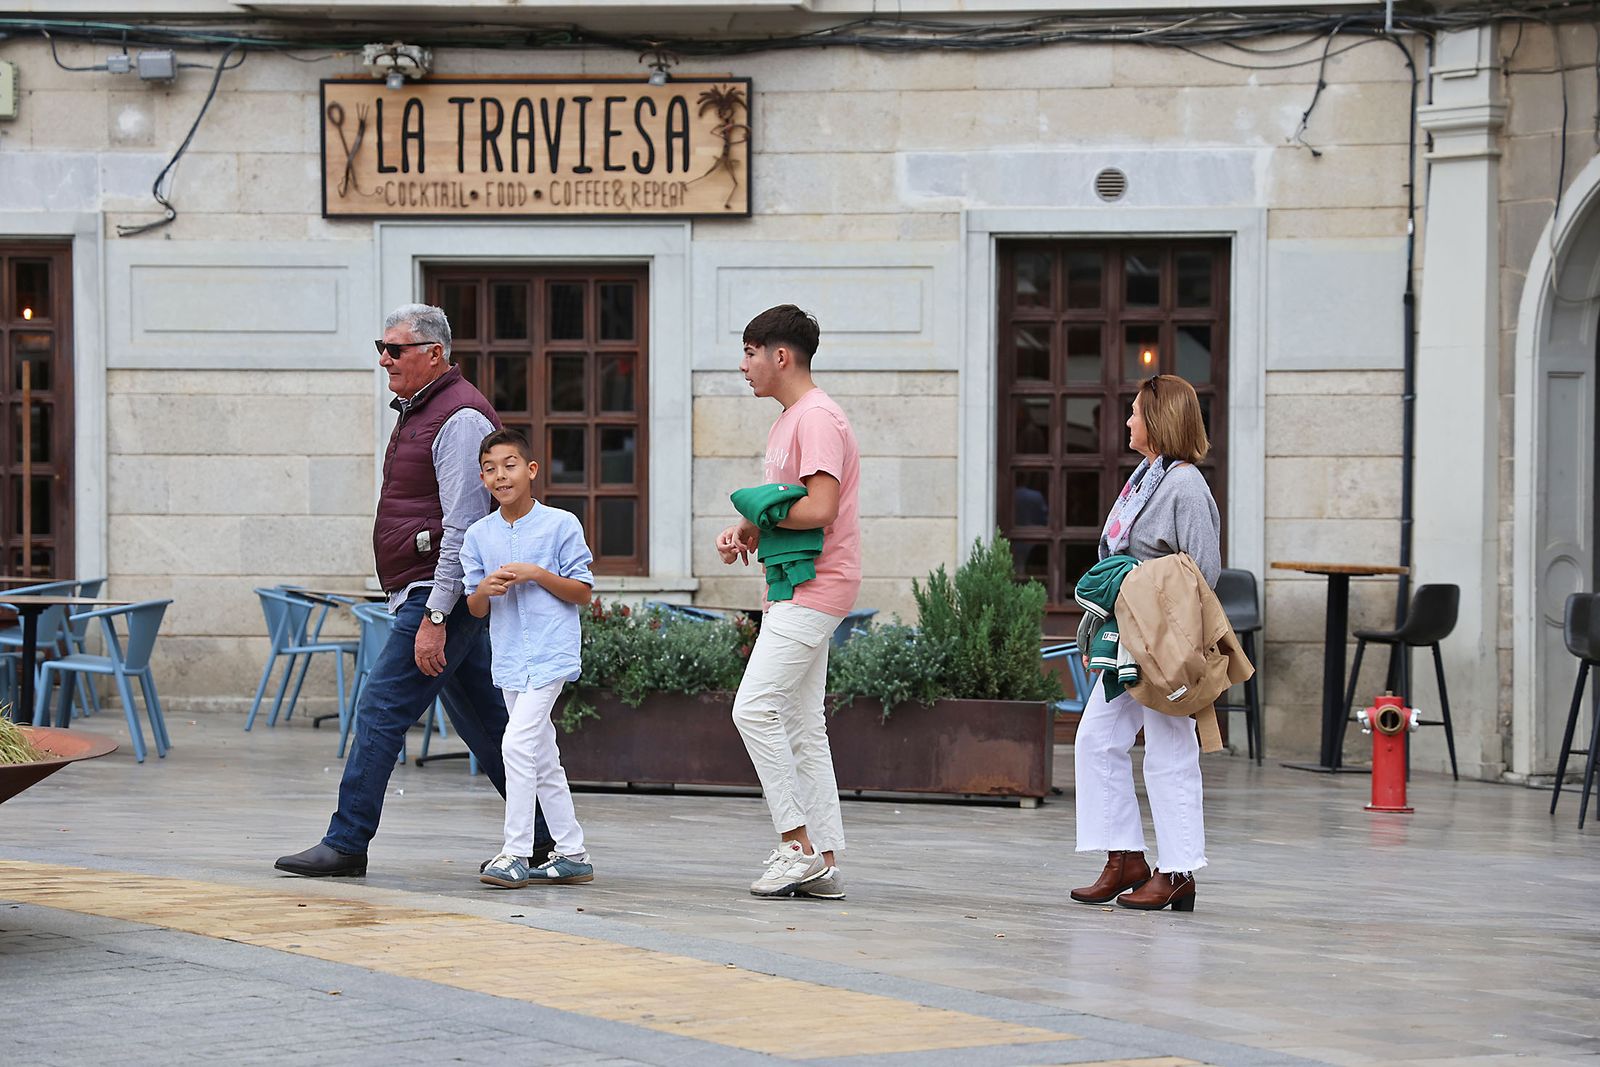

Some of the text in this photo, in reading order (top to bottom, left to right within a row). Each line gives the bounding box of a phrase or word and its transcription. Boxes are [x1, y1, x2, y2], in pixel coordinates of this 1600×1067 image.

[376, 95, 690, 174] LA TRAVIESA
[384, 180, 470, 208] COCKTAIL
[485, 181, 527, 208] FOOD
